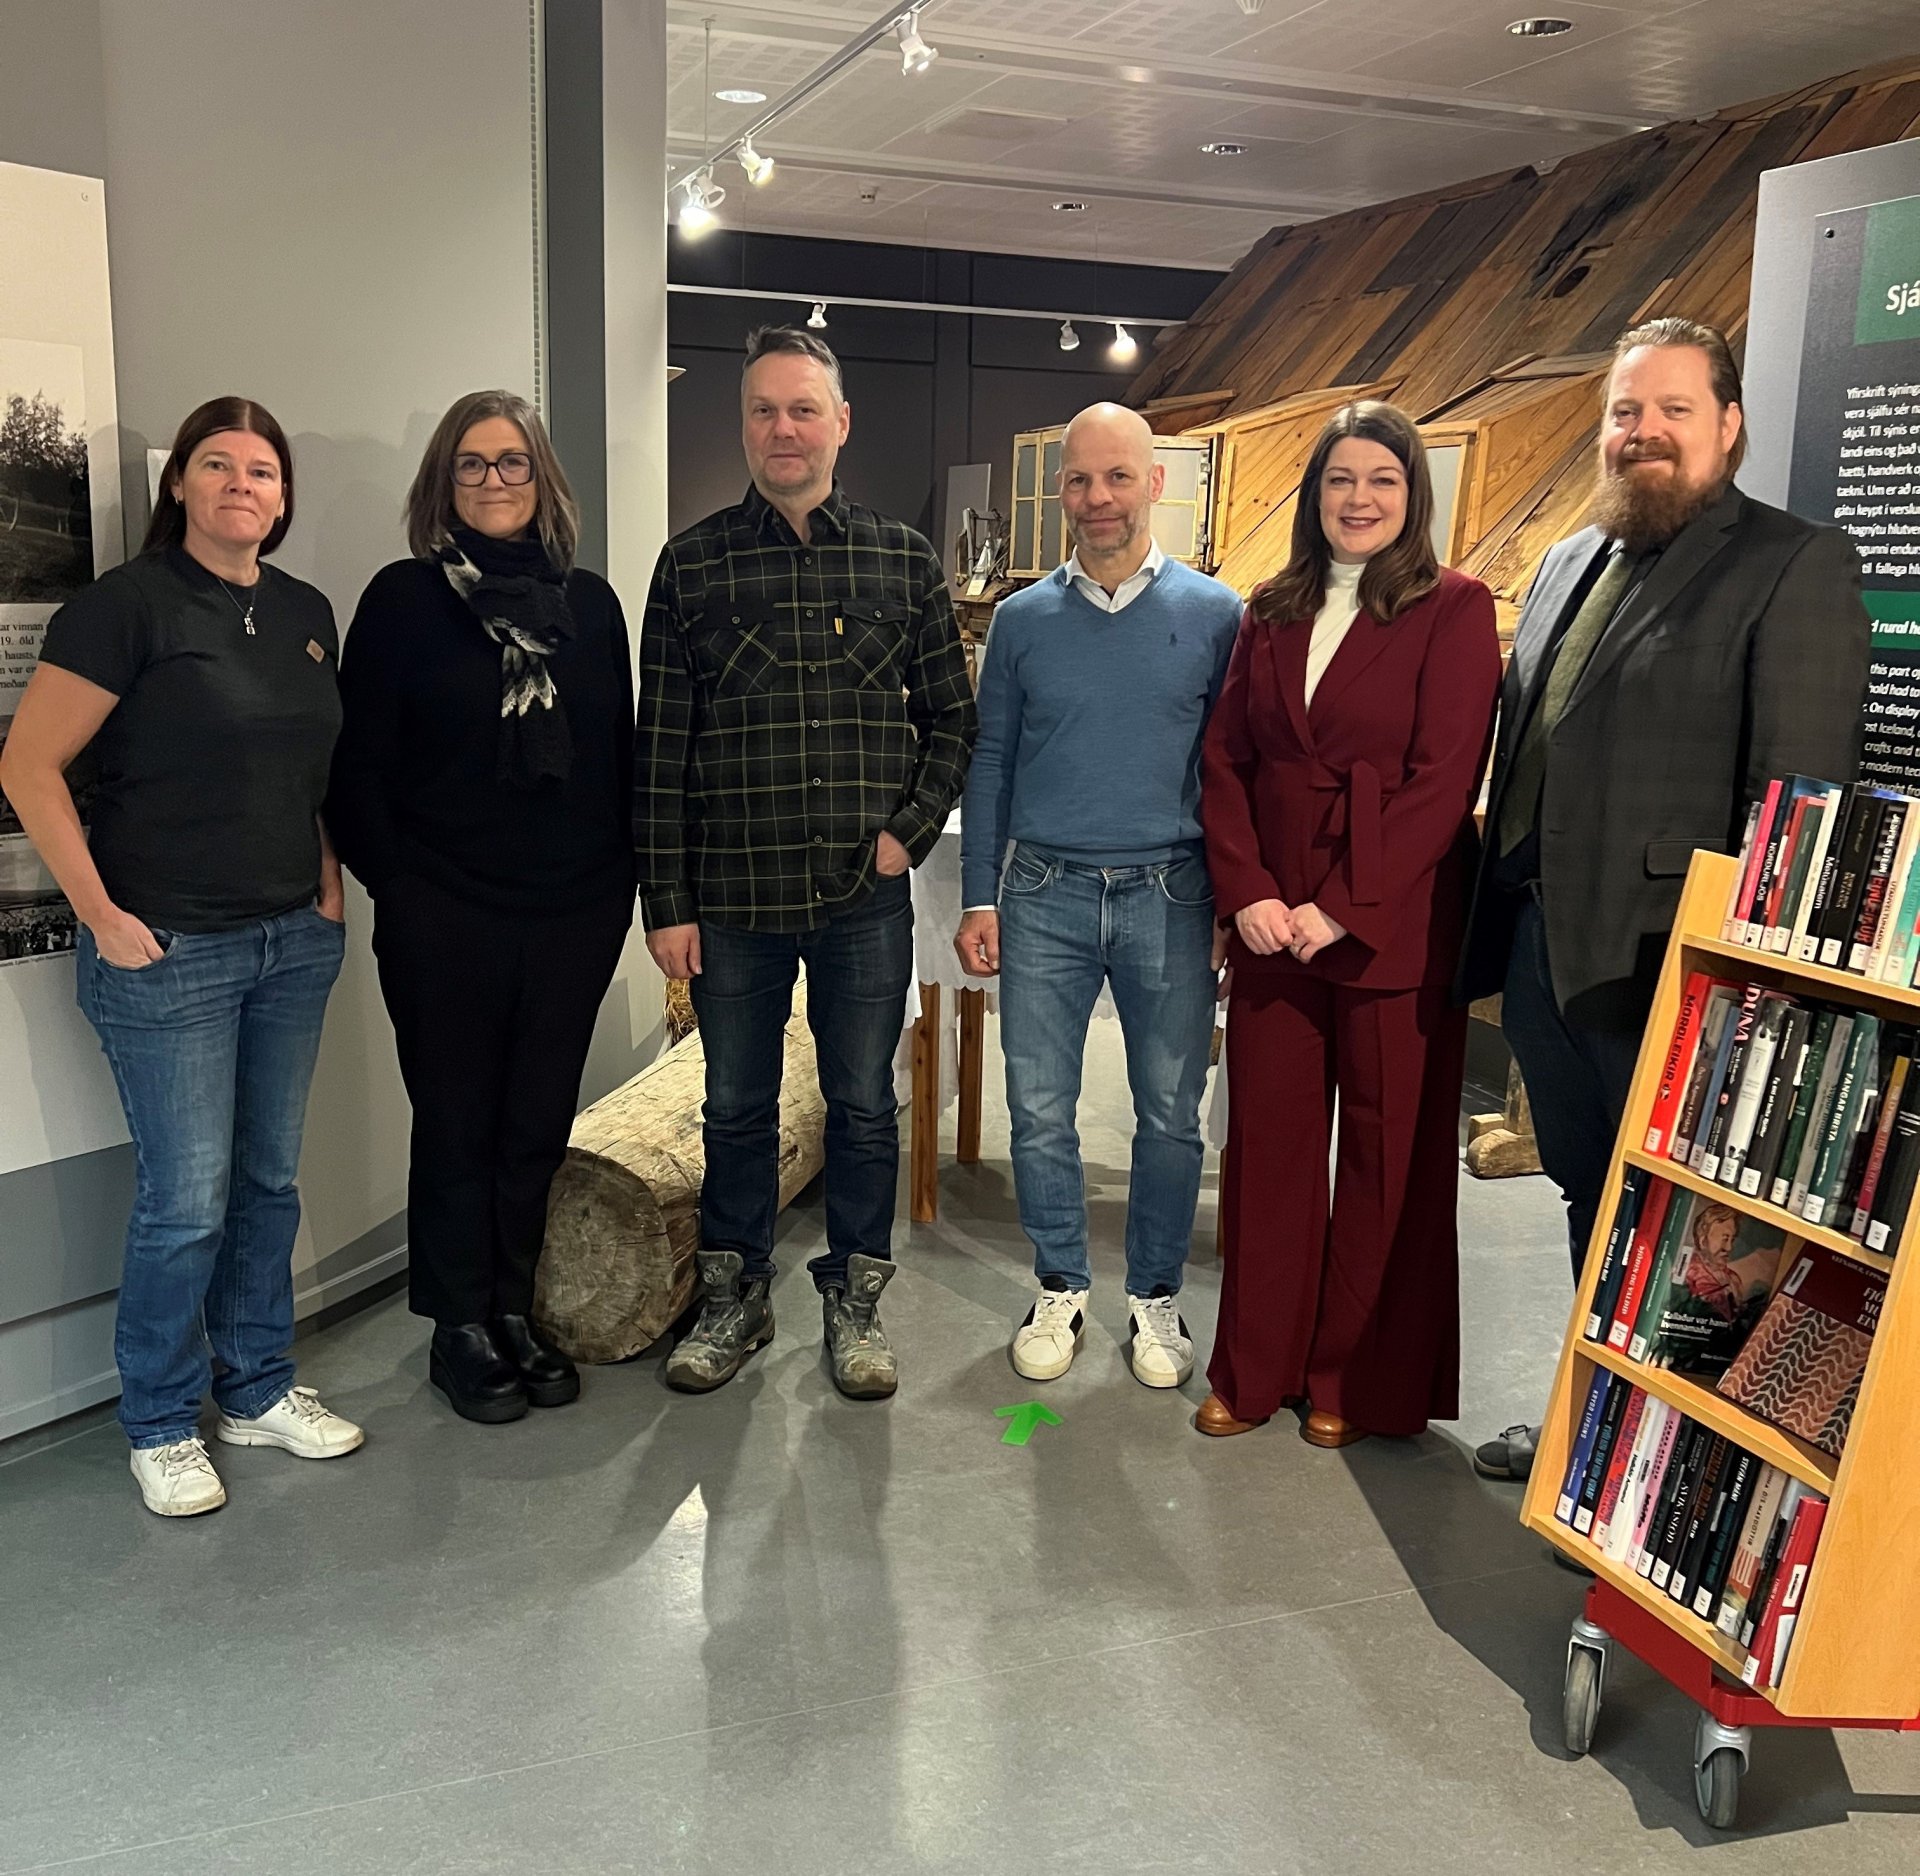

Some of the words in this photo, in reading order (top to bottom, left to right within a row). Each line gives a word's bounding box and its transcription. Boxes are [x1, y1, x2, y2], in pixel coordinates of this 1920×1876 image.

[1847, 385, 1886, 399] Yfirskrift
[1844, 409, 1865, 419] vera
[1866, 404, 1893, 420] sjálfu
[1893, 402, 1910, 415] sér
[1869, 425, 1881, 436] Til
[1883, 424, 1907, 438] sýnis
[1840, 445, 1864, 458] landi
[1864, 445, 1883, 456] eins
[1884, 446, 1896, 458] og
[1867, 463, 1913, 476] handverk
[1836, 485, 1866, 496] tækni.
[1867, 485, 1885, 496] Um
[1886, 486, 1897, 495] er
[1834, 504, 1855, 518] gátu
[1857, 504, 1883, 518] keypt
[1847, 523, 1887, 537] hagnýtu
[1875, 562, 1907, 577] fallega
[13, 623, 43, 631] vinnan
[1879, 621, 1910, 633] rural
[8, 666, 23, 674] var
[1870, 663, 1888, 675] this
[1888, 667, 1910, 678] part
[1889, 684, 1910, 696] had
[1869, 702, 1884, 713] On
[1885, 704, 1920, 719] display
[1878, 723, 1915, 738] Iceland,
[1864, 741, 1891, 754] crafts
[1892, 745, 1914, 756] and
[1865, 762, 1903, 774] modern
